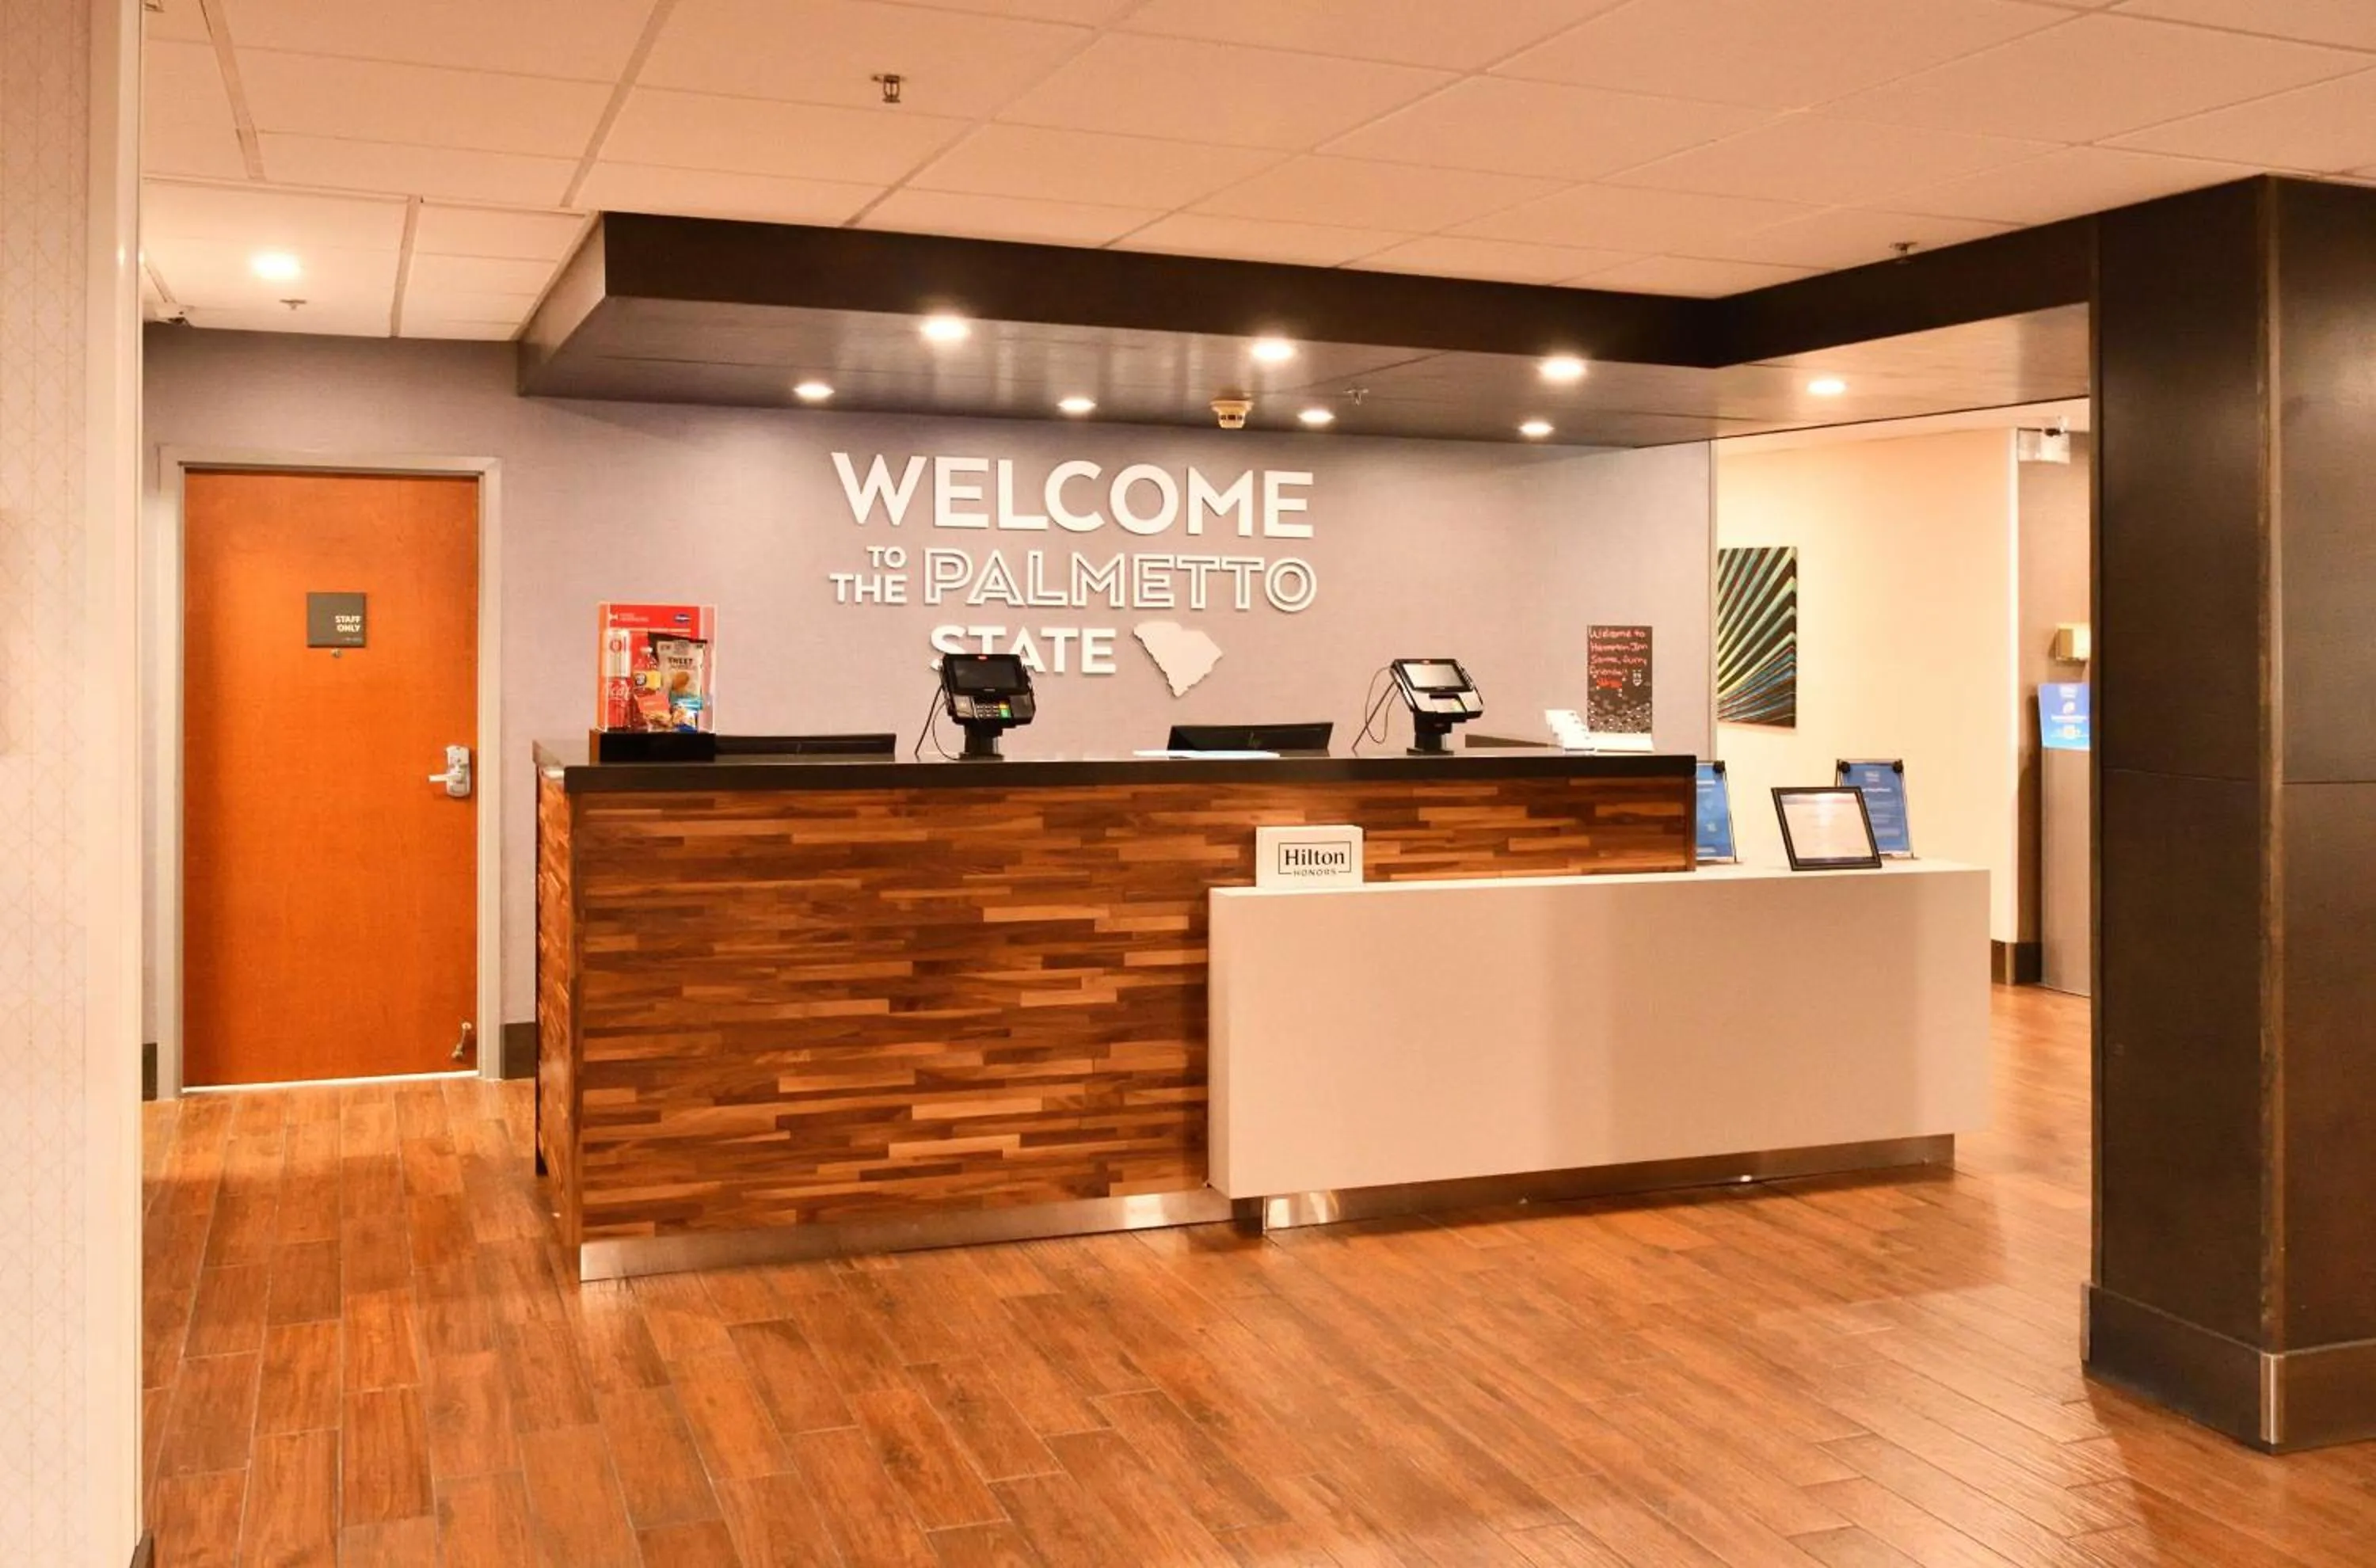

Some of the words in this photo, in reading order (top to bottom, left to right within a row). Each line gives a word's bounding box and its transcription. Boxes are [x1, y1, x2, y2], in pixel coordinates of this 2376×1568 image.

[831, 452, 1314, 539] WELCOME
[866, 546, 907, 569] TO
[829, 573, 908, 605] THE
[923, 548, 1318, 613] PALMETTO
[337, 624, 361, 633] ONLY
[1285, 848, 1345, 866] Hilton
[1293, 868, 1337, 877] HONORS
